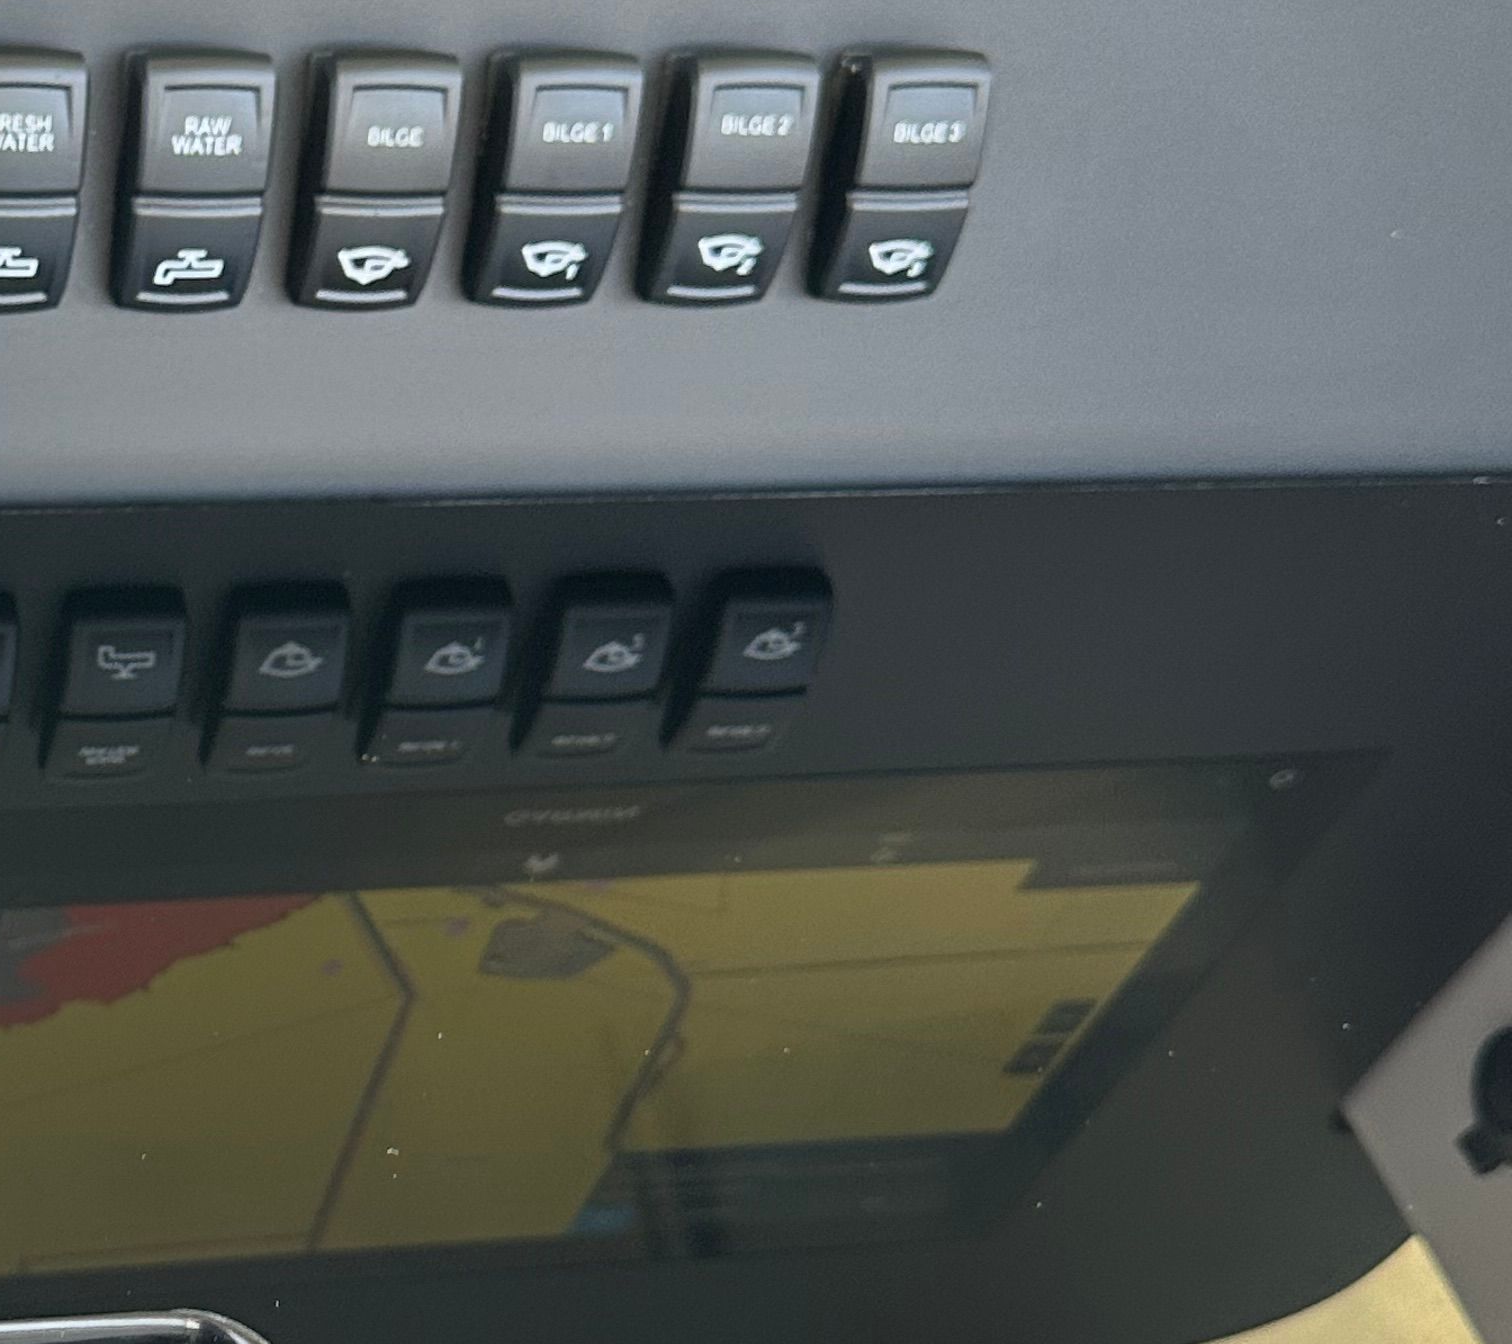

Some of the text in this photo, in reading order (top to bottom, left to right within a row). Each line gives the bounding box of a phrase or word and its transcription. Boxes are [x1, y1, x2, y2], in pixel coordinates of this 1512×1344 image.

[184, 116, 231, 136] RAW
[366, 124, 424, 148] BILGE
[542, 120, 612, 143] BILGE 1
[720, 113, 774, 136] BILGE
[893, 121, 947, 144] BILGE
[172, 134, 242, 157] WATER
